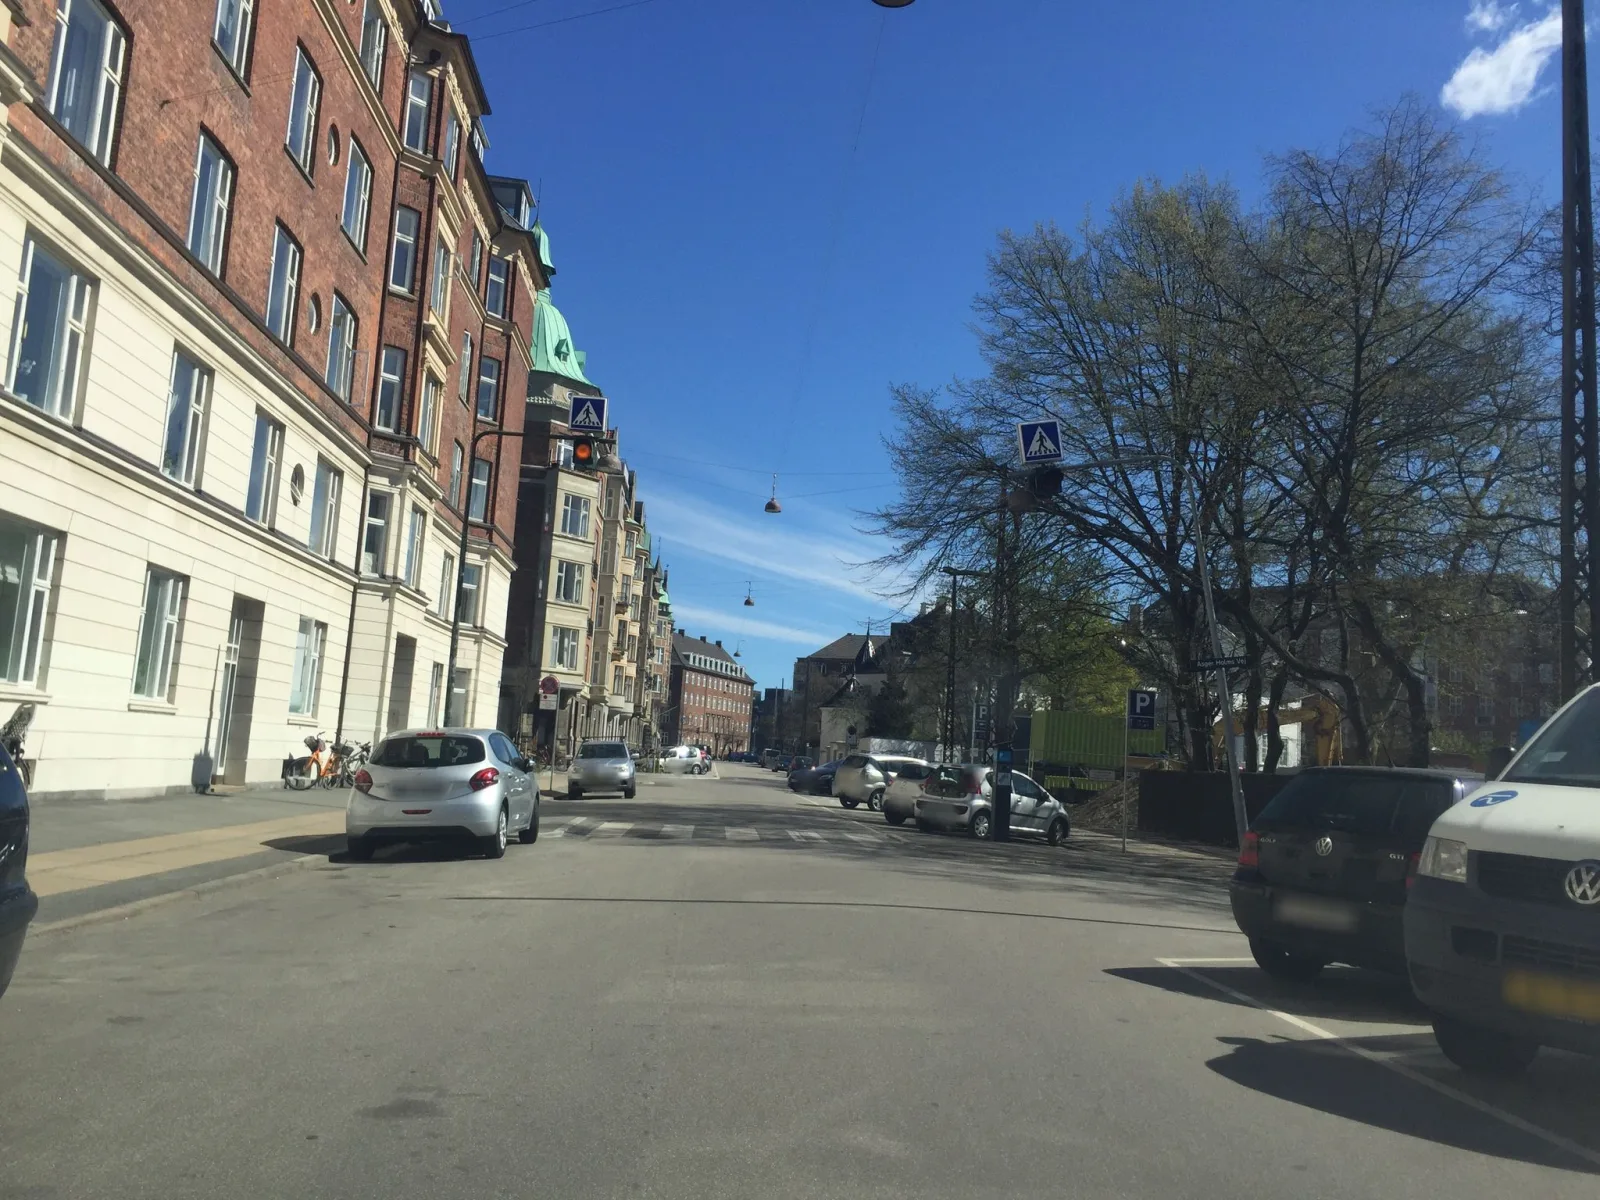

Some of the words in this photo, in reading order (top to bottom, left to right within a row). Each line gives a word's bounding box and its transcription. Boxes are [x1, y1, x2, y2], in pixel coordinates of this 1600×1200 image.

[1236, 657, 1247, 665] Vej
[1135, 692, 1151, 714] P
[979, 704, 989, 719] P
[1389, 852, 1405, 861] GTI
